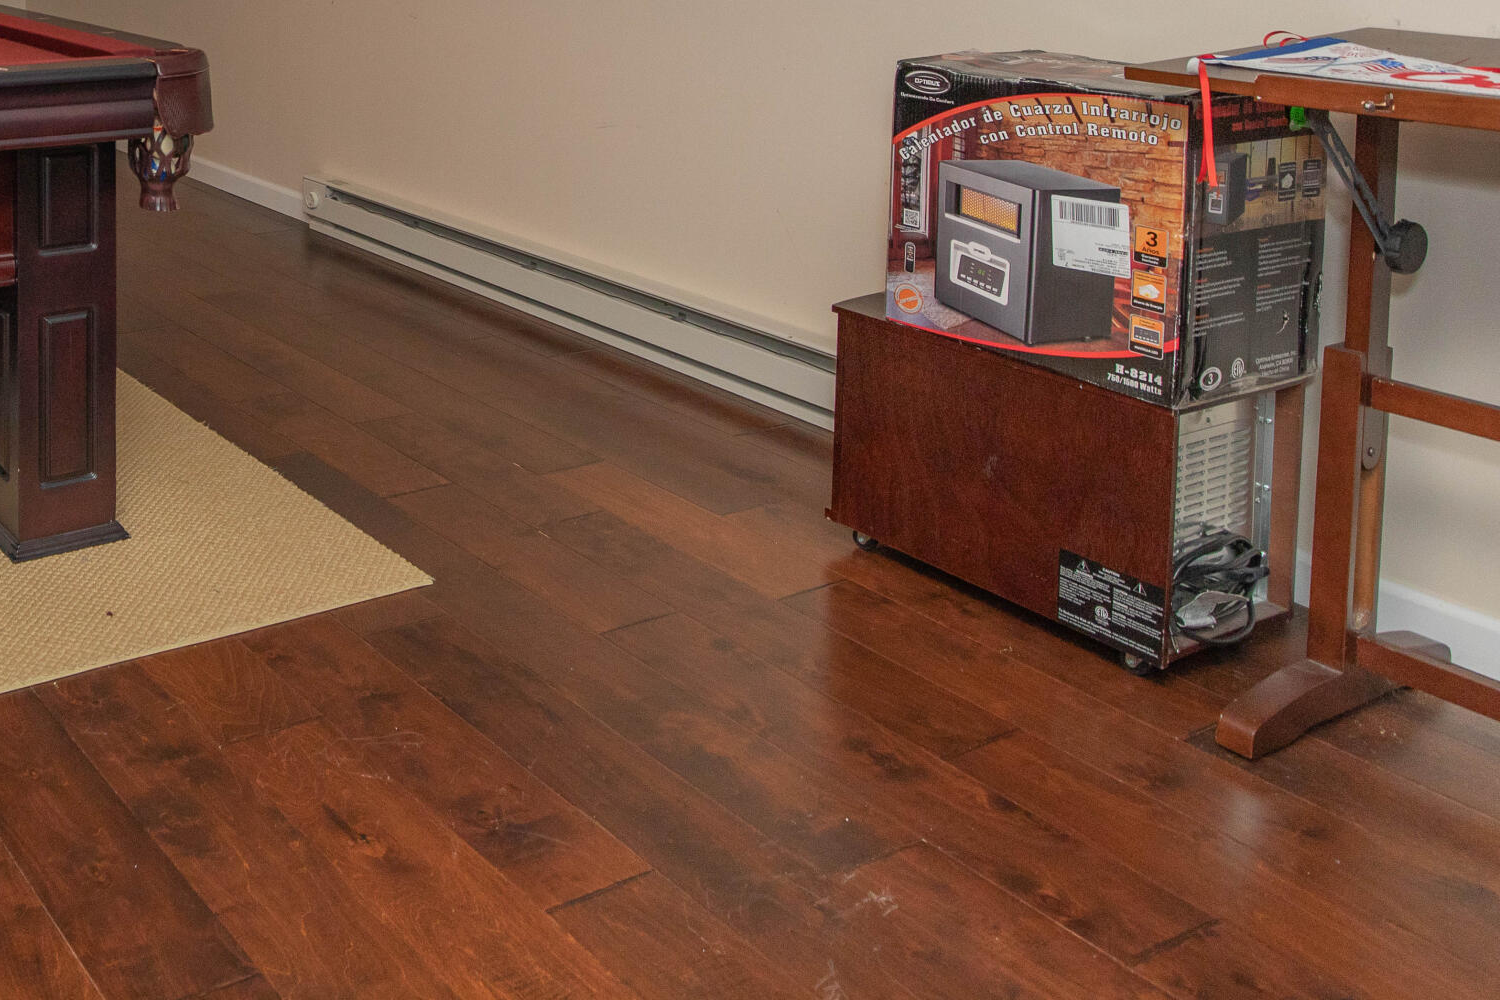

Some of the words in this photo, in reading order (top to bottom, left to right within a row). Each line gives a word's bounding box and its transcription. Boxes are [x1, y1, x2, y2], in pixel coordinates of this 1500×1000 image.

[899, 113, 978, 161] Calentador
[983, 105, 1004, 124] de
[1008, 102, 1074, 118] Cuarzo
[1081, 101, 1183, 131] Infrarrojo
[979, 131, 1009, 146] con
[1015, 122, 1079, 138] Control
[1087, 123, 1159, 146] Remoto
[1146, 231, 1158, 248] 3
[1107, 372, 1139, 390] 750/1500
[1139, 382, 1162, 396] Watts
[1115, 363, 1163, 387] H-8214
[1208, 373, 1214, 385] 3
